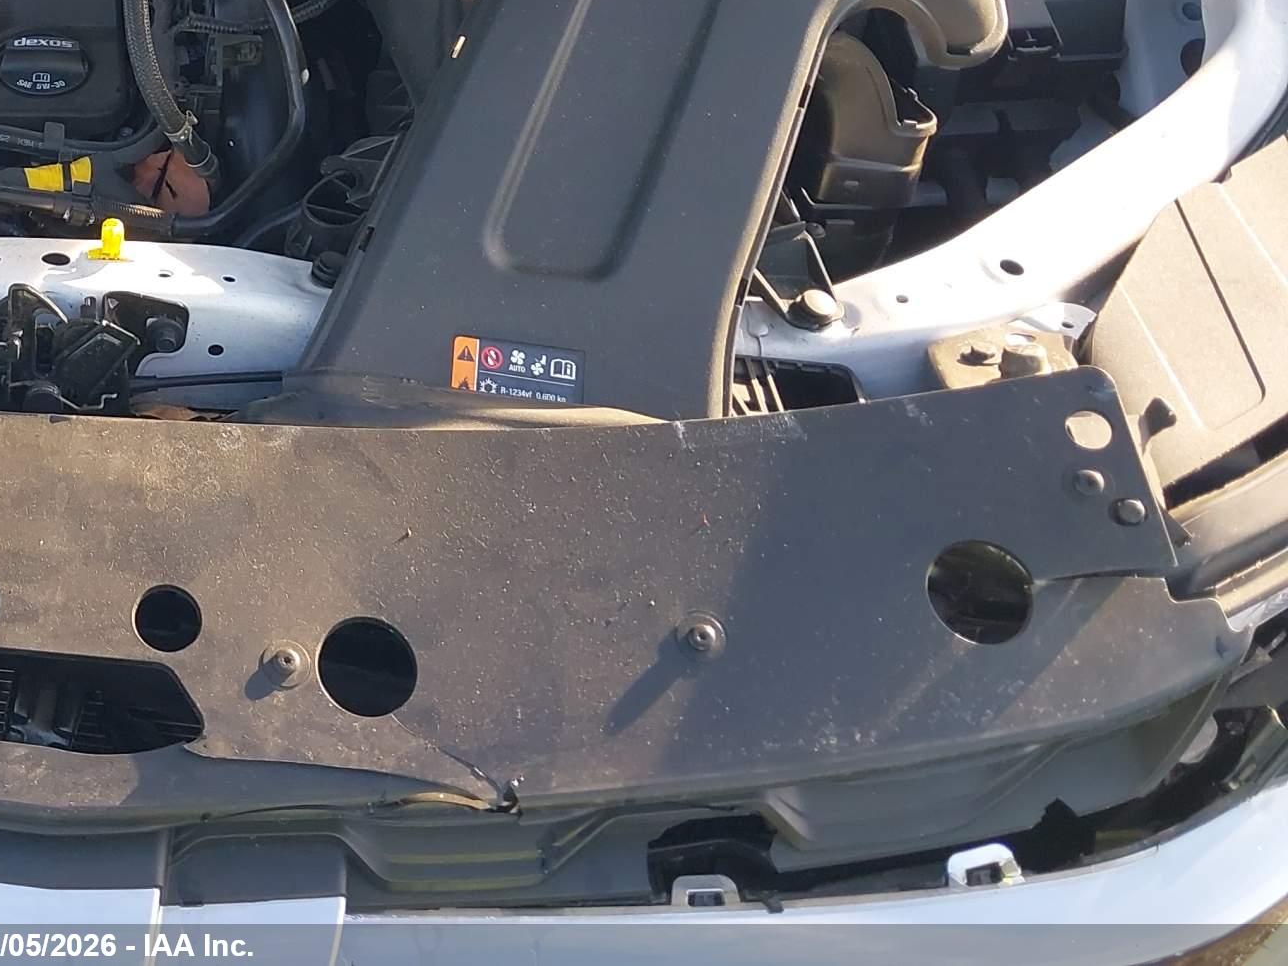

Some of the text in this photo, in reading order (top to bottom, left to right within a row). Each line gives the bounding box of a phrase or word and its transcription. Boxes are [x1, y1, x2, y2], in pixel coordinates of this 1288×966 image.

[14, 37, 73, 47] dexos
[16, 79, 66, 90] SAE 5W-30
[509, 365, 526, 373] AUTO
